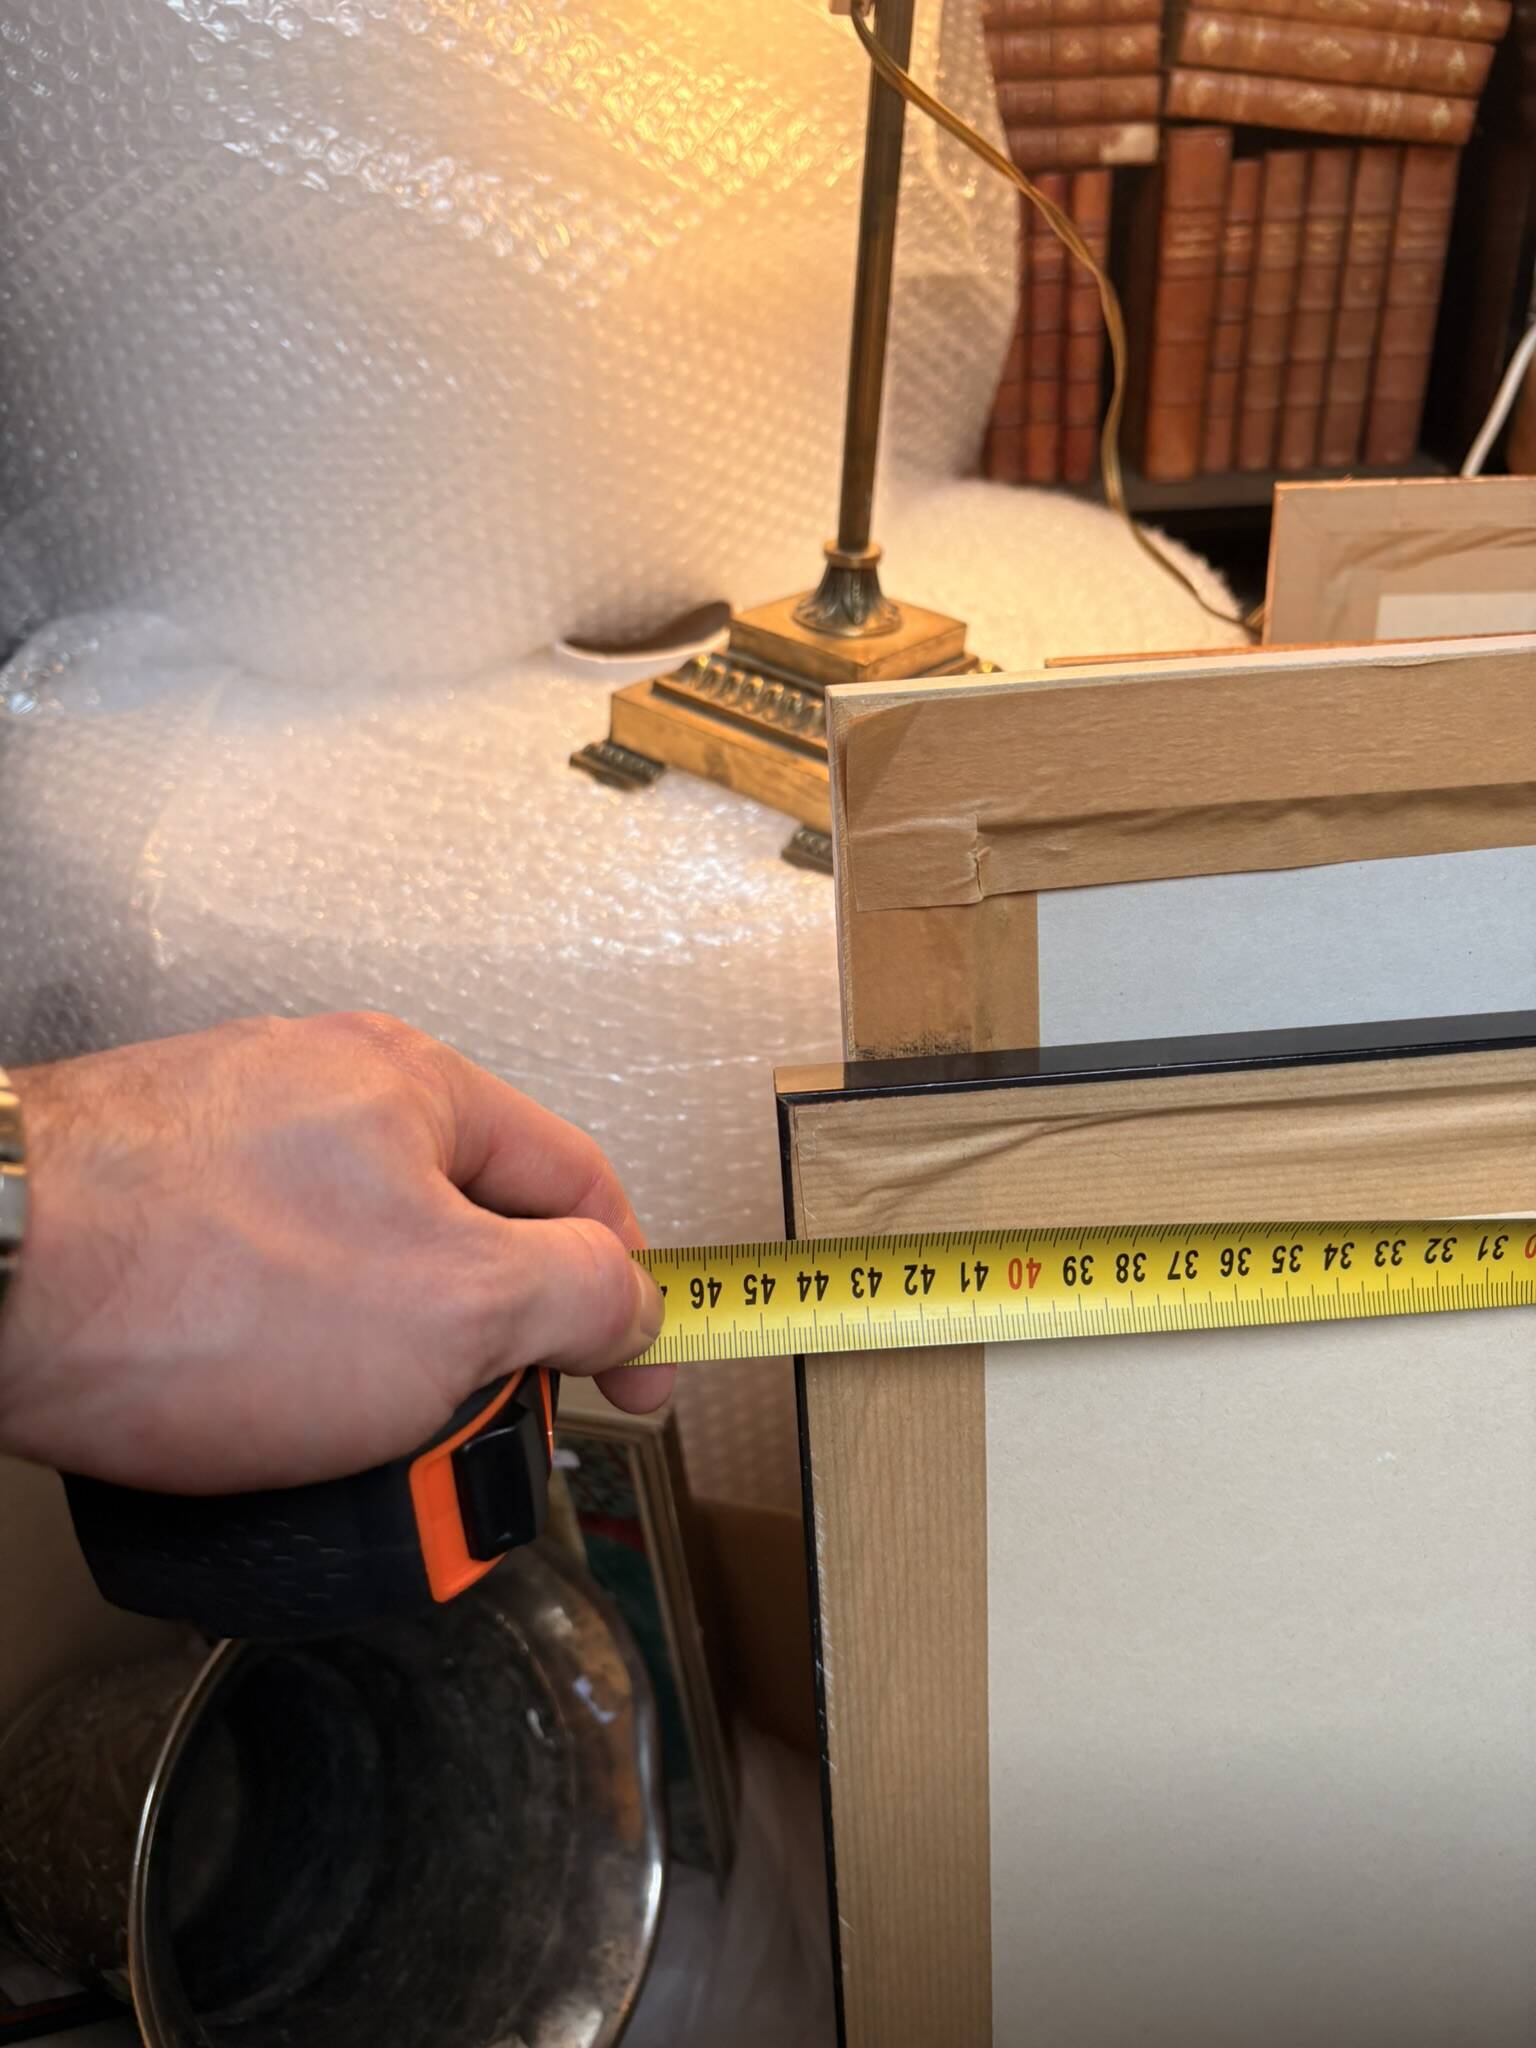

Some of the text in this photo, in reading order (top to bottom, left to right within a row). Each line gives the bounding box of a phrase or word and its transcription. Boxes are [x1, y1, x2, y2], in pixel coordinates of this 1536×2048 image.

[1221, 1247, 1251, 1277] 36
[1272, 1245, 1303, 1273] 35
[1324, 1242, 1354, 1270] 34
[1375, 1239, 1406, 1267] 33
[1425, 1237, 1457, 1264] 32
[1477, 1234, 1509, 1261] 31
[904, 1264, 935, 1295] 42
[960, 1261, 988, 1292] 41
[1008, 1257, 1042, 1290] 40
[1063, 1255, 1094, 1286] 39
[1116, 1253, 1146, 1283] 38
[1168, 1250, 1198, 1280] 37
[690, 1277, 722, 1309] 46
[744, 1274, 775, 1305] 45
[797, 1270, 829, 1302] 44
[851, 1267, 882, 1298] 43
